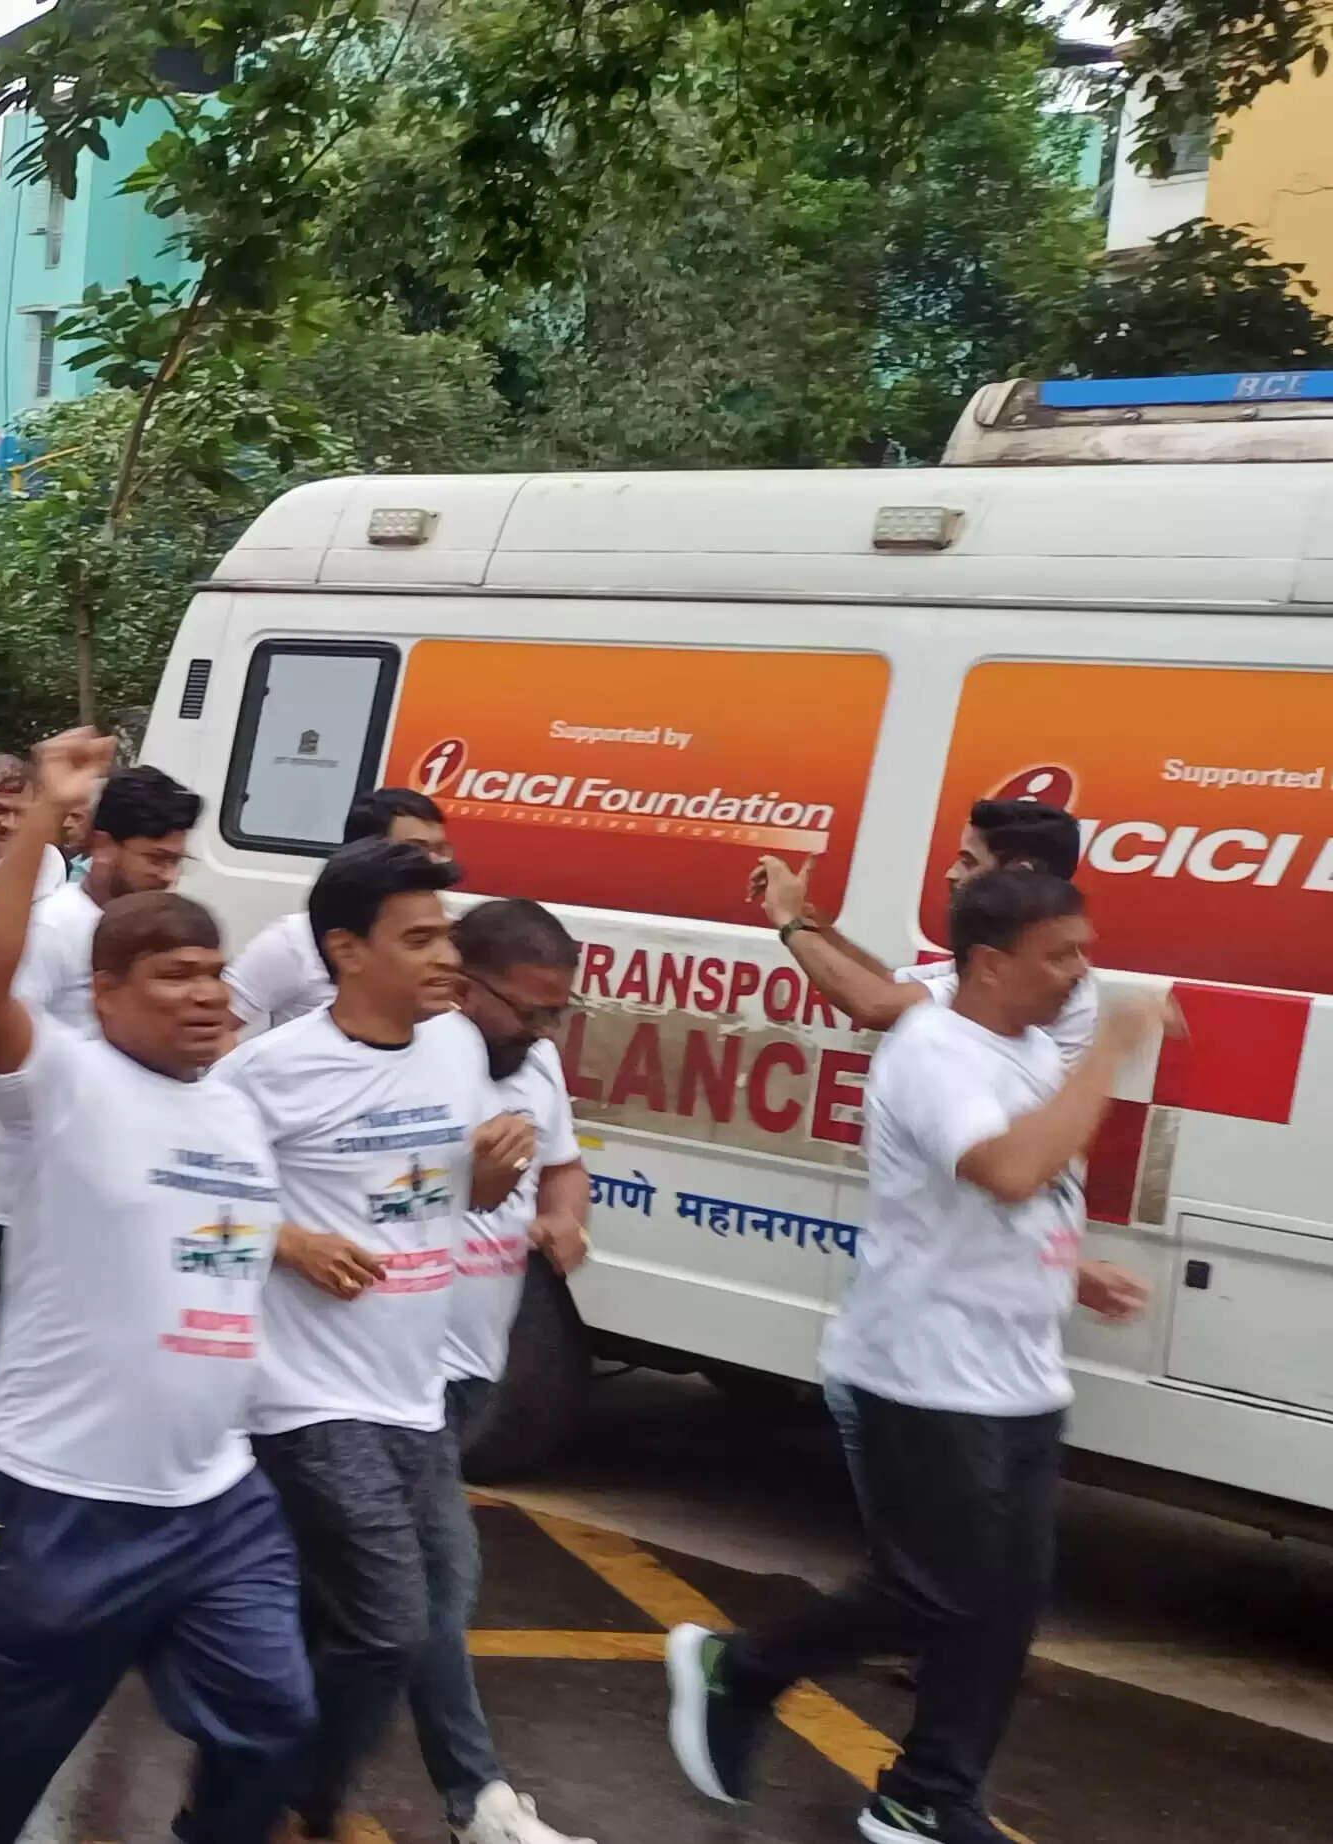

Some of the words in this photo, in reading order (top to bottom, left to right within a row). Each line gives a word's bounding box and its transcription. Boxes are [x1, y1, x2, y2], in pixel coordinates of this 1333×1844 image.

[548, 720, 660, 746] Supported
[662, 728, 694, 751] by
[455, 768, 577, 807] ICICI
[573, 777, 835, 831] Foundation
[1162, 757, 1325, 790] Supported
[576, 941, 863, 1033] RANSPOR
[563, 1011, 872, 1146] LANCE
[590, 1169, 656, 1217] ठाणे
